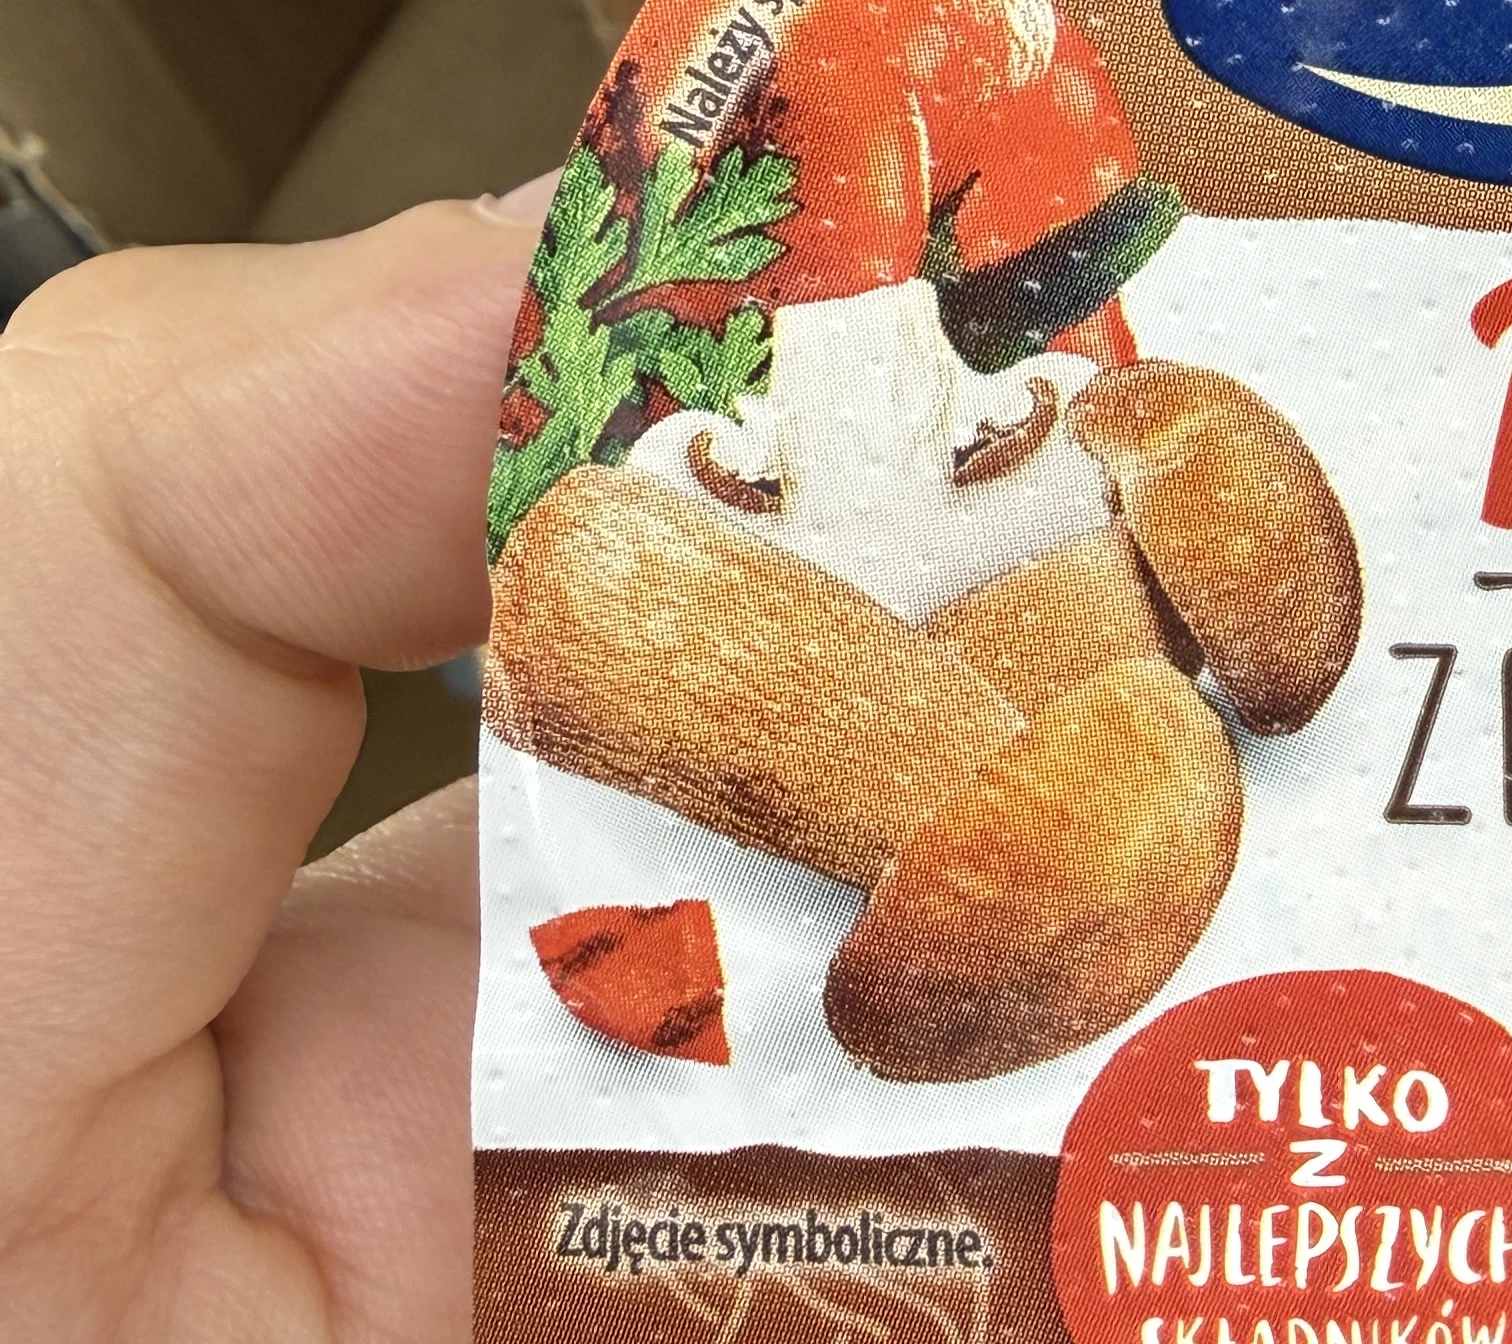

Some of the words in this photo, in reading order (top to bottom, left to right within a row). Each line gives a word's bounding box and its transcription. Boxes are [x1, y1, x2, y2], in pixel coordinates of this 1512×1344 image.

[660, 6, 775, 147] Należy
[1384, 641, 1473, 825] Z
[1194, 1058, 1450, 1133] TYLKO
[1289, 1138, 1348, 1188] Z
[558, 1201, 702, 1275] Zdjęcie
[716, 1206, 994, 1278] symboliczne.
